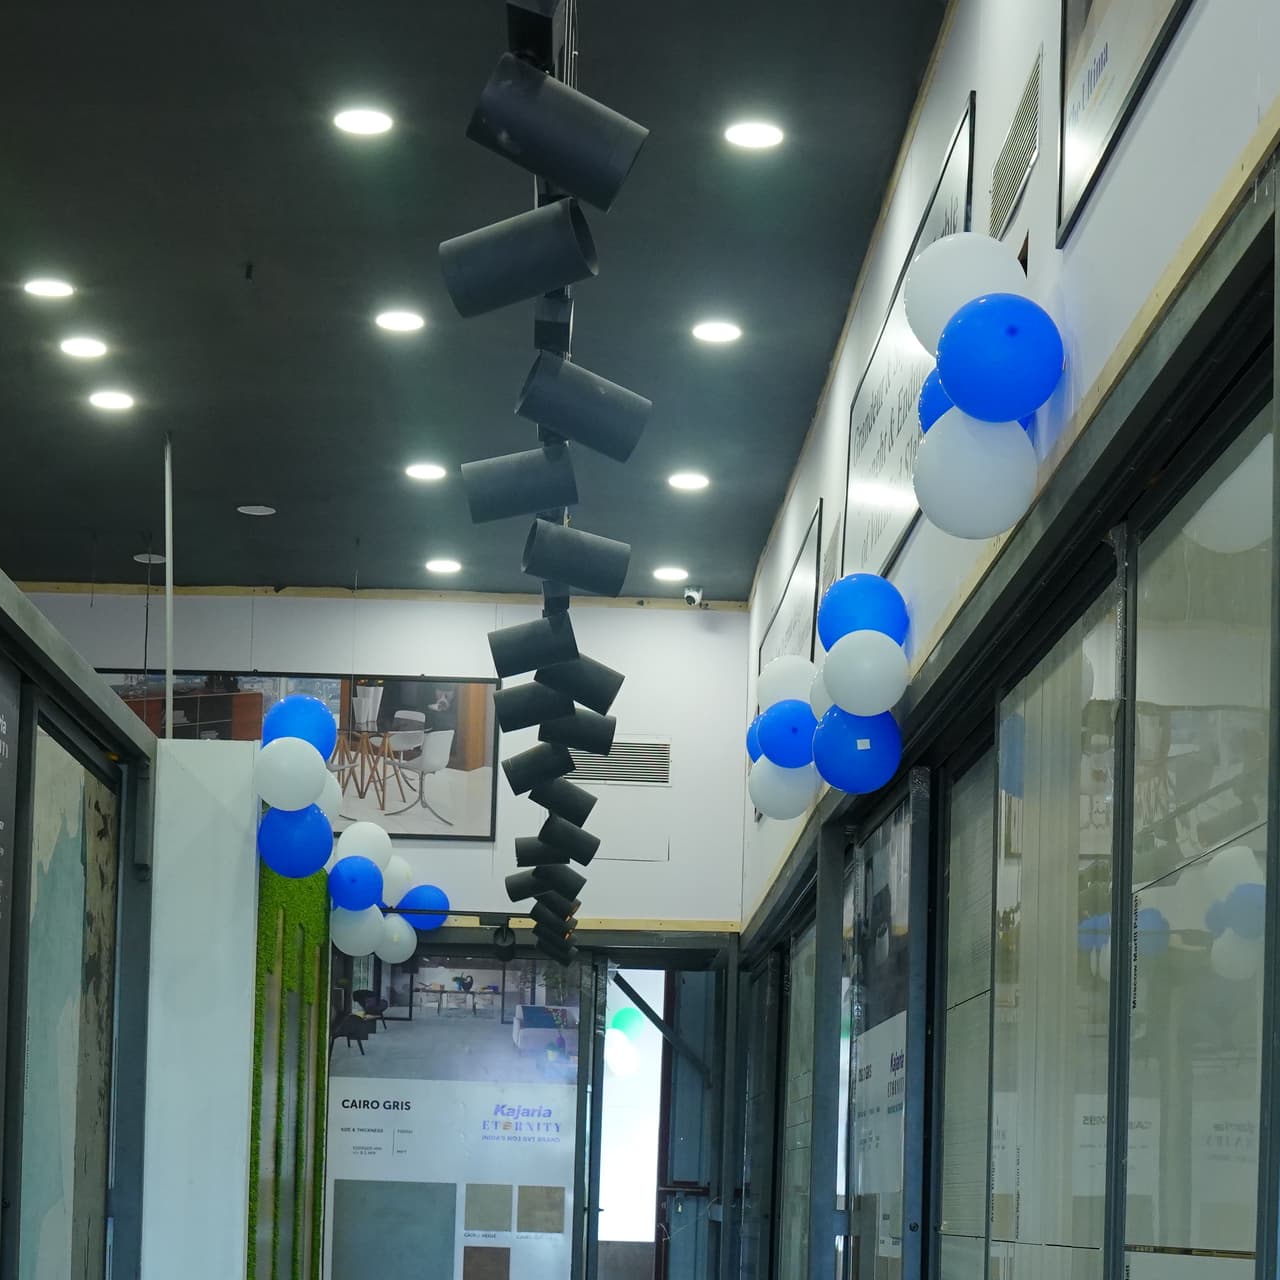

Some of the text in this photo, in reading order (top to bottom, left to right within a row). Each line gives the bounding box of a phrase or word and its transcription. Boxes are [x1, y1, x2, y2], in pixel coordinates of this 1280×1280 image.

[341, 1098, 412, 1111] CAIRO GRIS
[493, 1104, 552, 1120] Kajaria
[482, 1120, 561, 1133] ETERNITY
